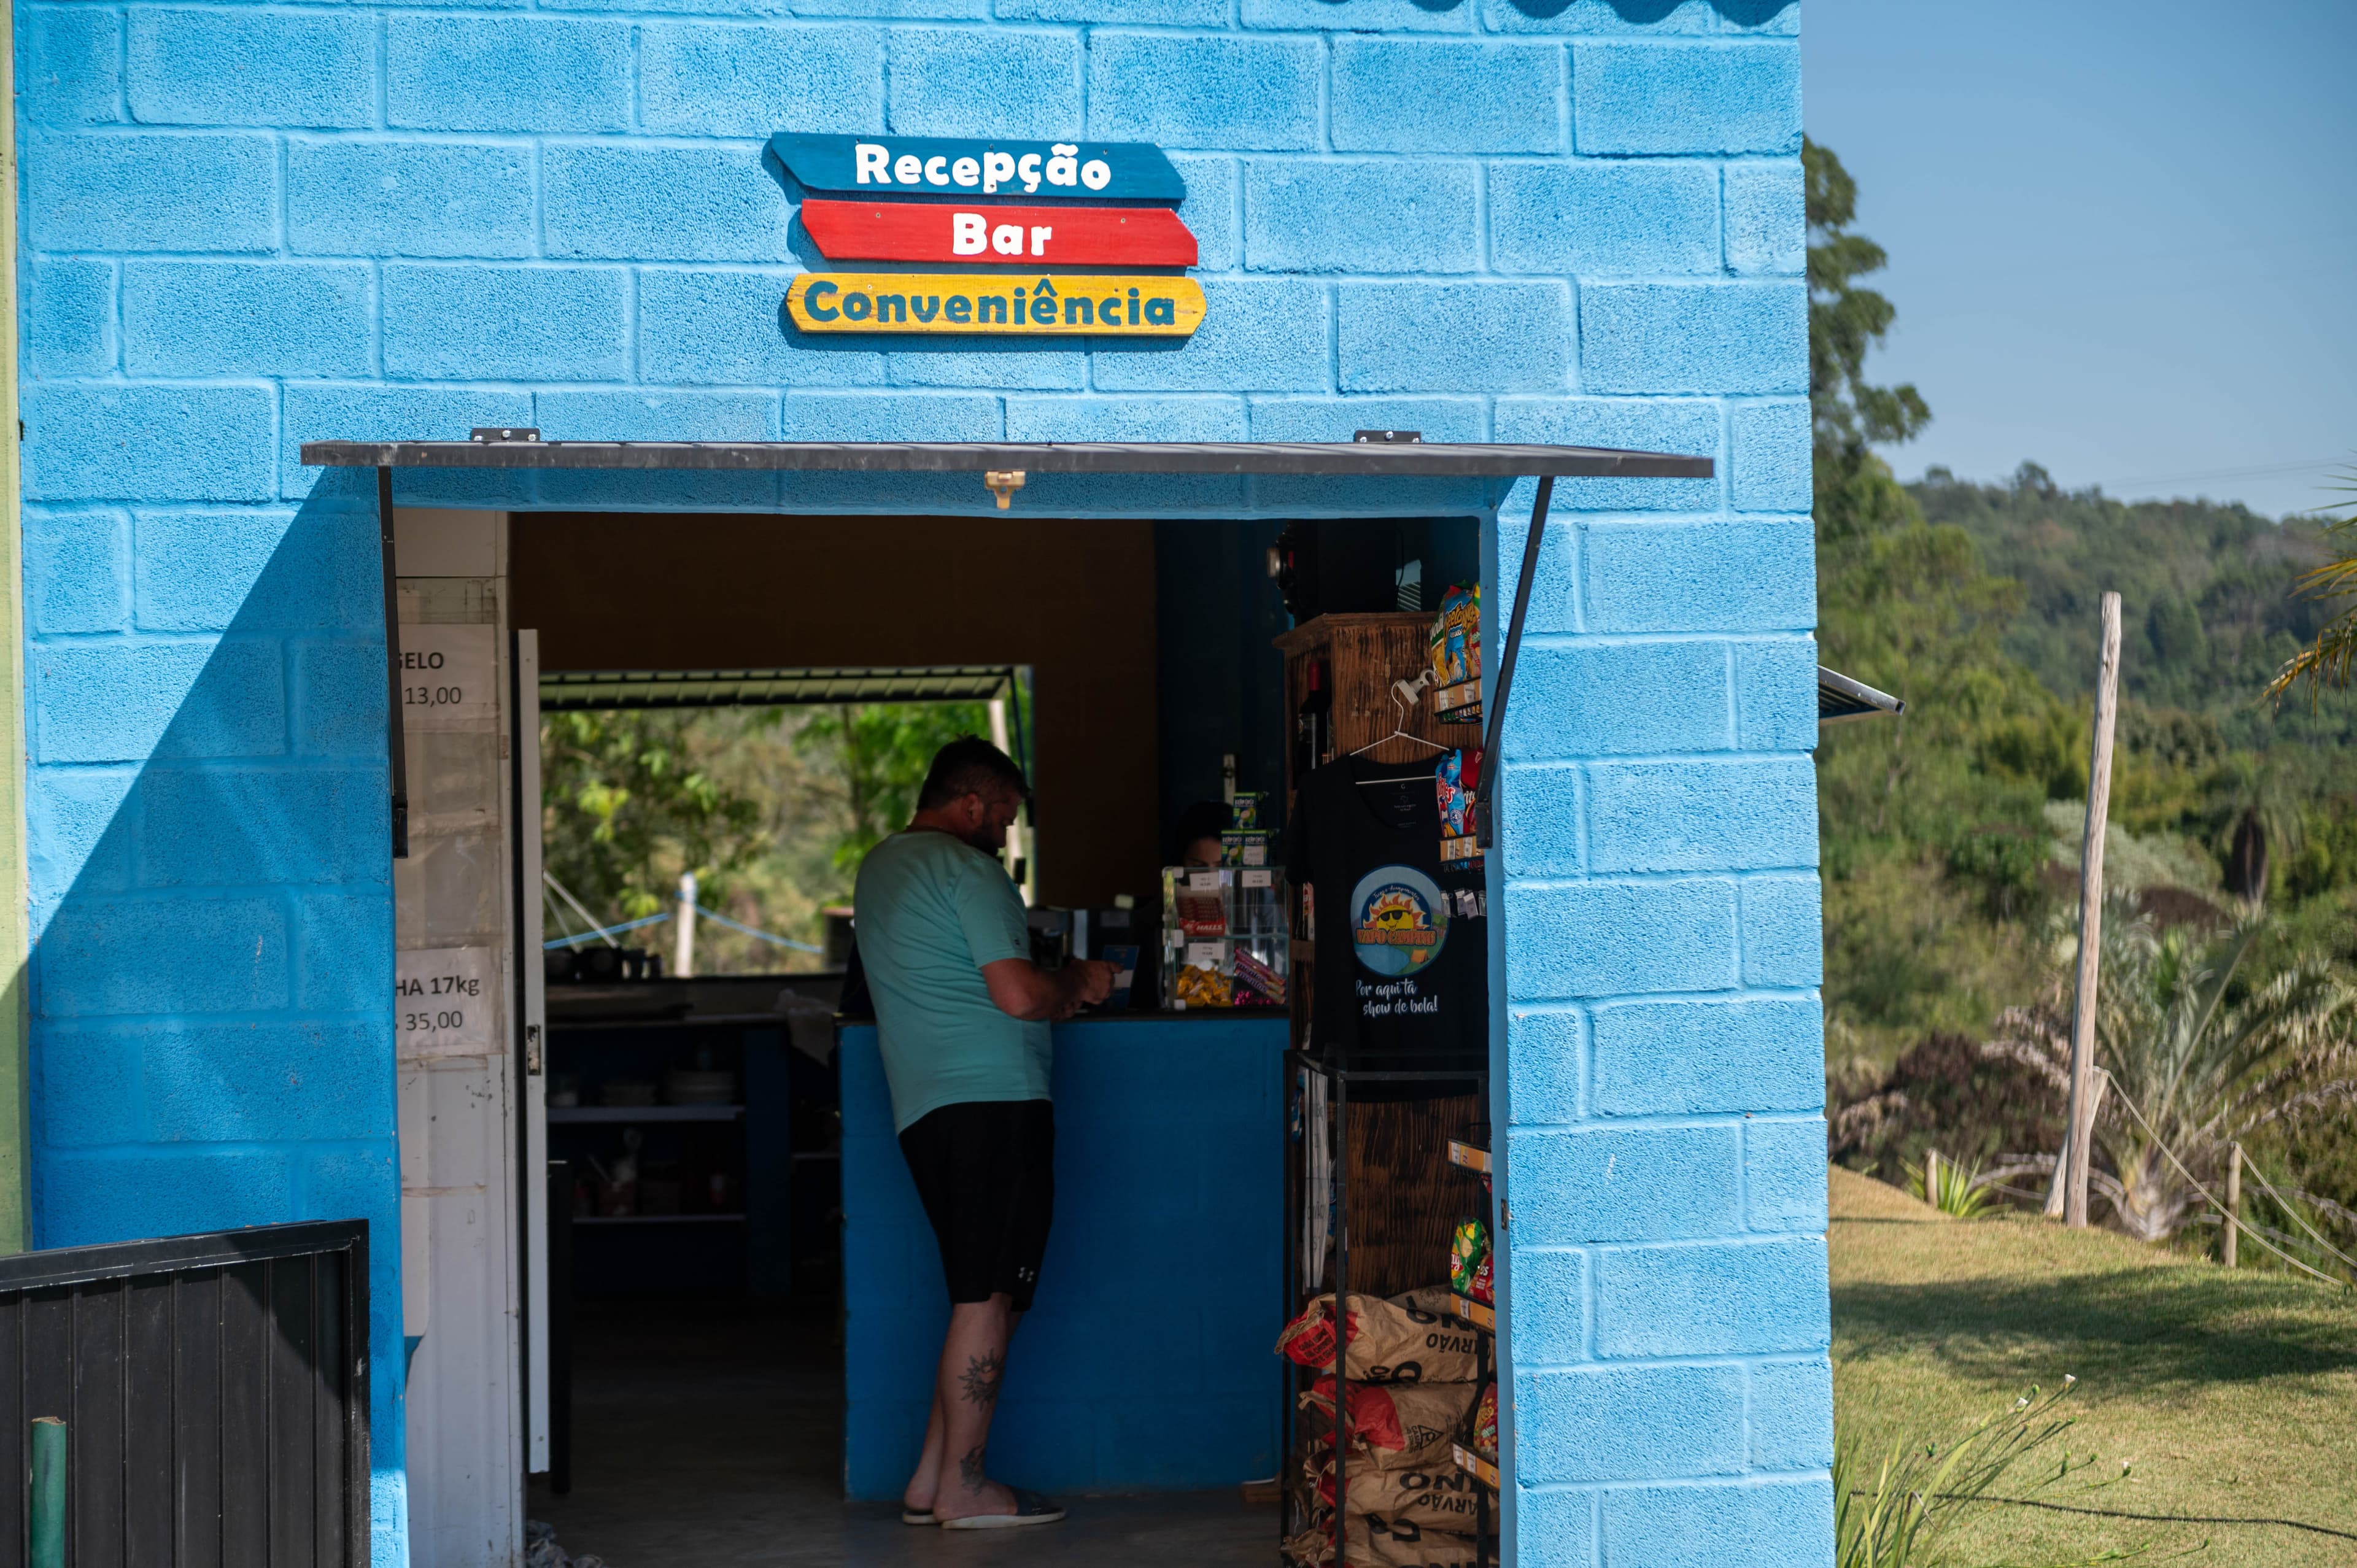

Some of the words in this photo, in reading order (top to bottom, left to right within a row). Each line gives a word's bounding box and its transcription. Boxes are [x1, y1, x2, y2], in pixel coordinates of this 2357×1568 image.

[855, 142, 1112, 193] Recepção
[952, 212, 1052, 257] Bar
[803, 279, 1175, 326] Conveniência
[400, 652, 444, 670] ELO
[404, 687, 462, 708] 13,00
[1388, 930, 1436, 945] CAMPING
[431, 975, 481, 997] 17kg
[1355, 979, 1372, 997] Por
[1375, 981, 1401, 1000] aqui
[1363, 1000, 1391, 1019] show
[1395, 997, 1409, 1015] de
[1410, 994, 1438, 1014] bola!
[406, 1010, 463, 1033] 35,00
[1426, 1332, 1491, 1360] RVÃO
[1417, 1493, 1490, 1516] ARVÃO
